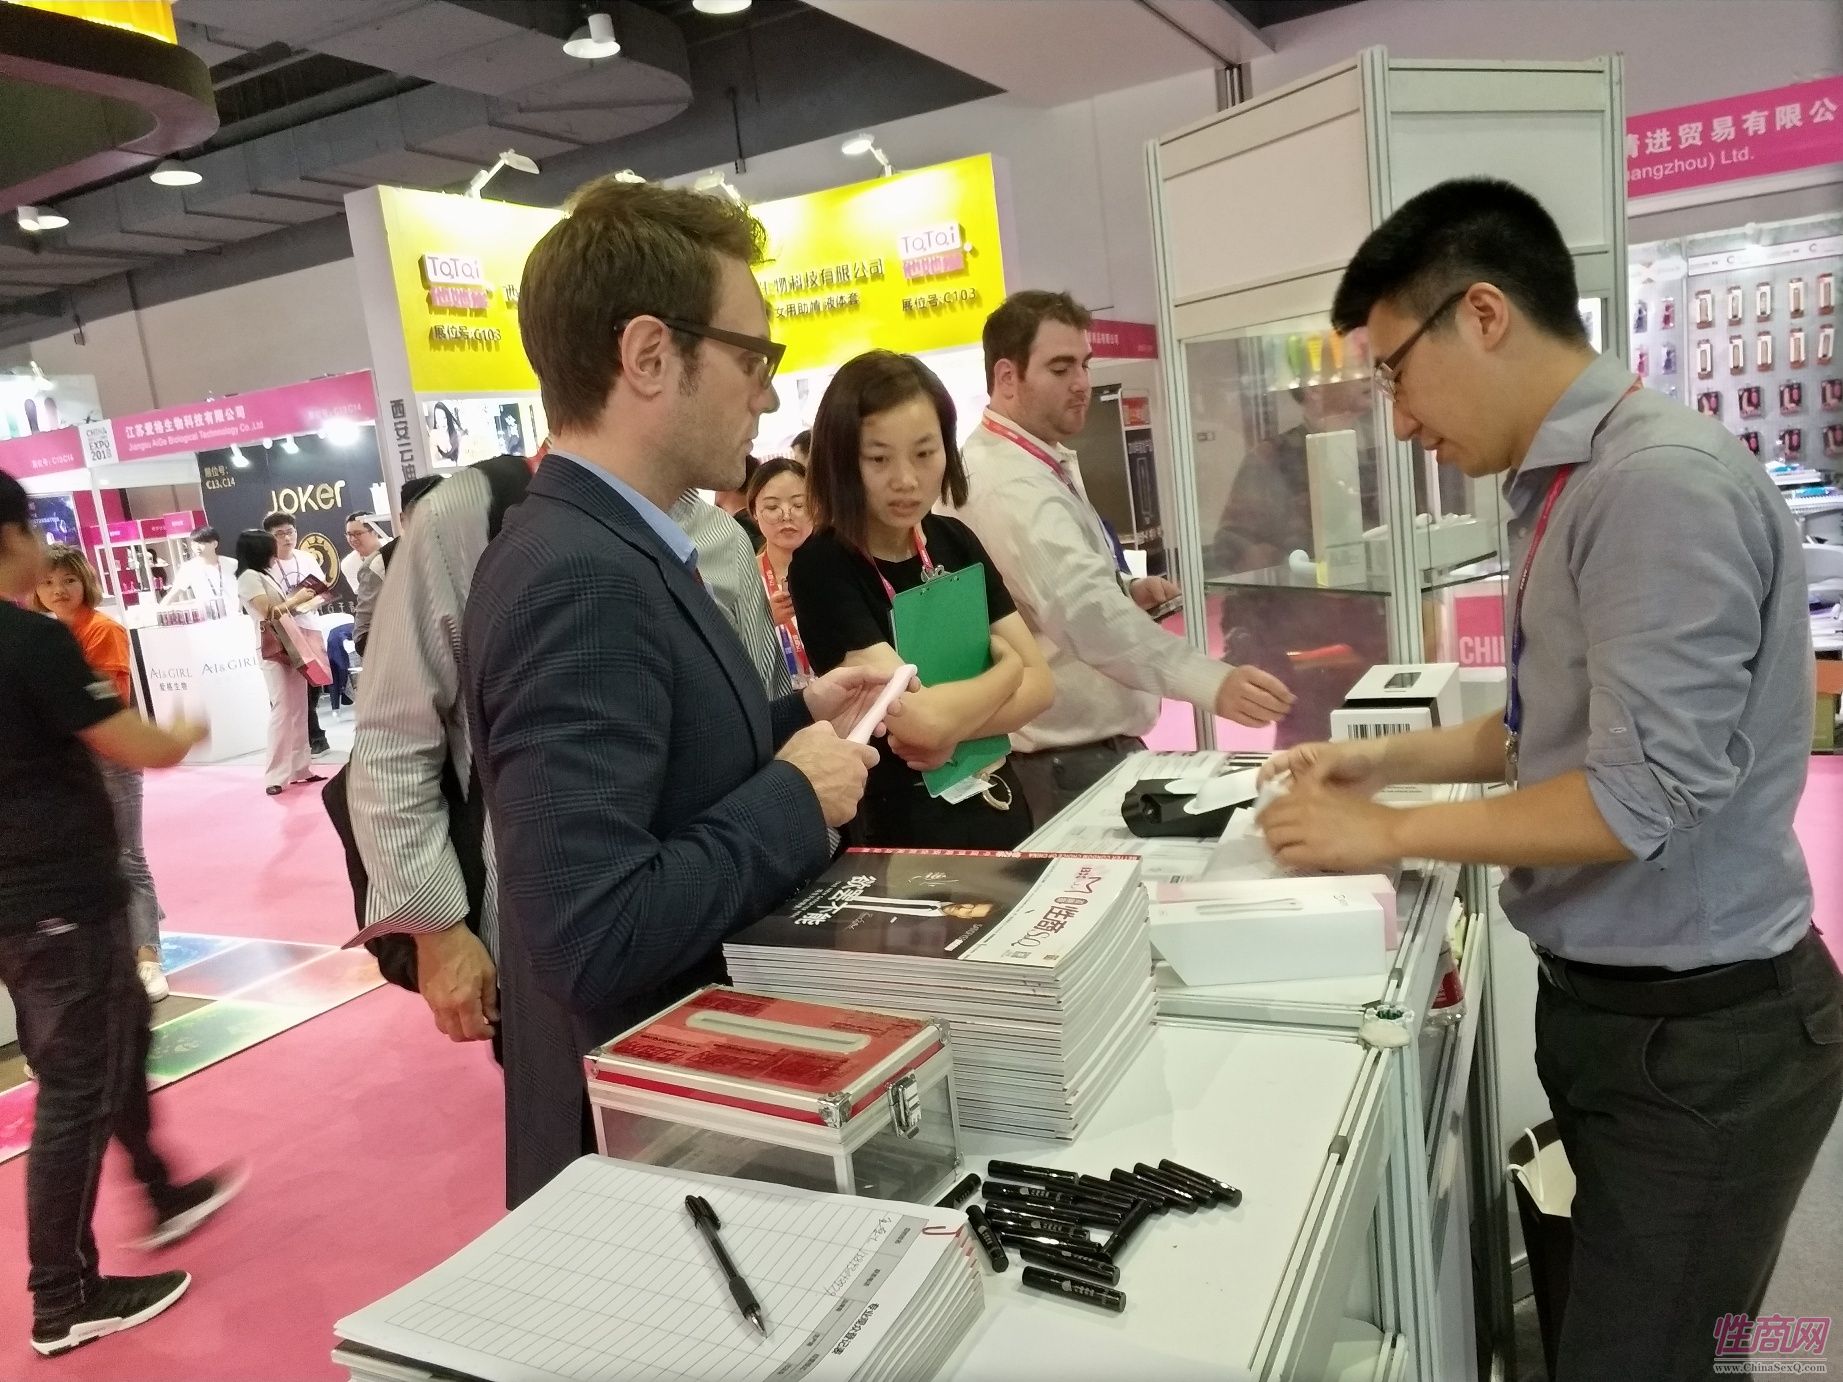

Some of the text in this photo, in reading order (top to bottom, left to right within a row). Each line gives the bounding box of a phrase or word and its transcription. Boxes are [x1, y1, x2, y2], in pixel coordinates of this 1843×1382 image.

[1720, 146, 1755, 165] Ltd.
[89, 440, 110, 451] EXPO
[91, 449, 112, 461] 2018
[794, 875, 877, 926] 欲罢不能
